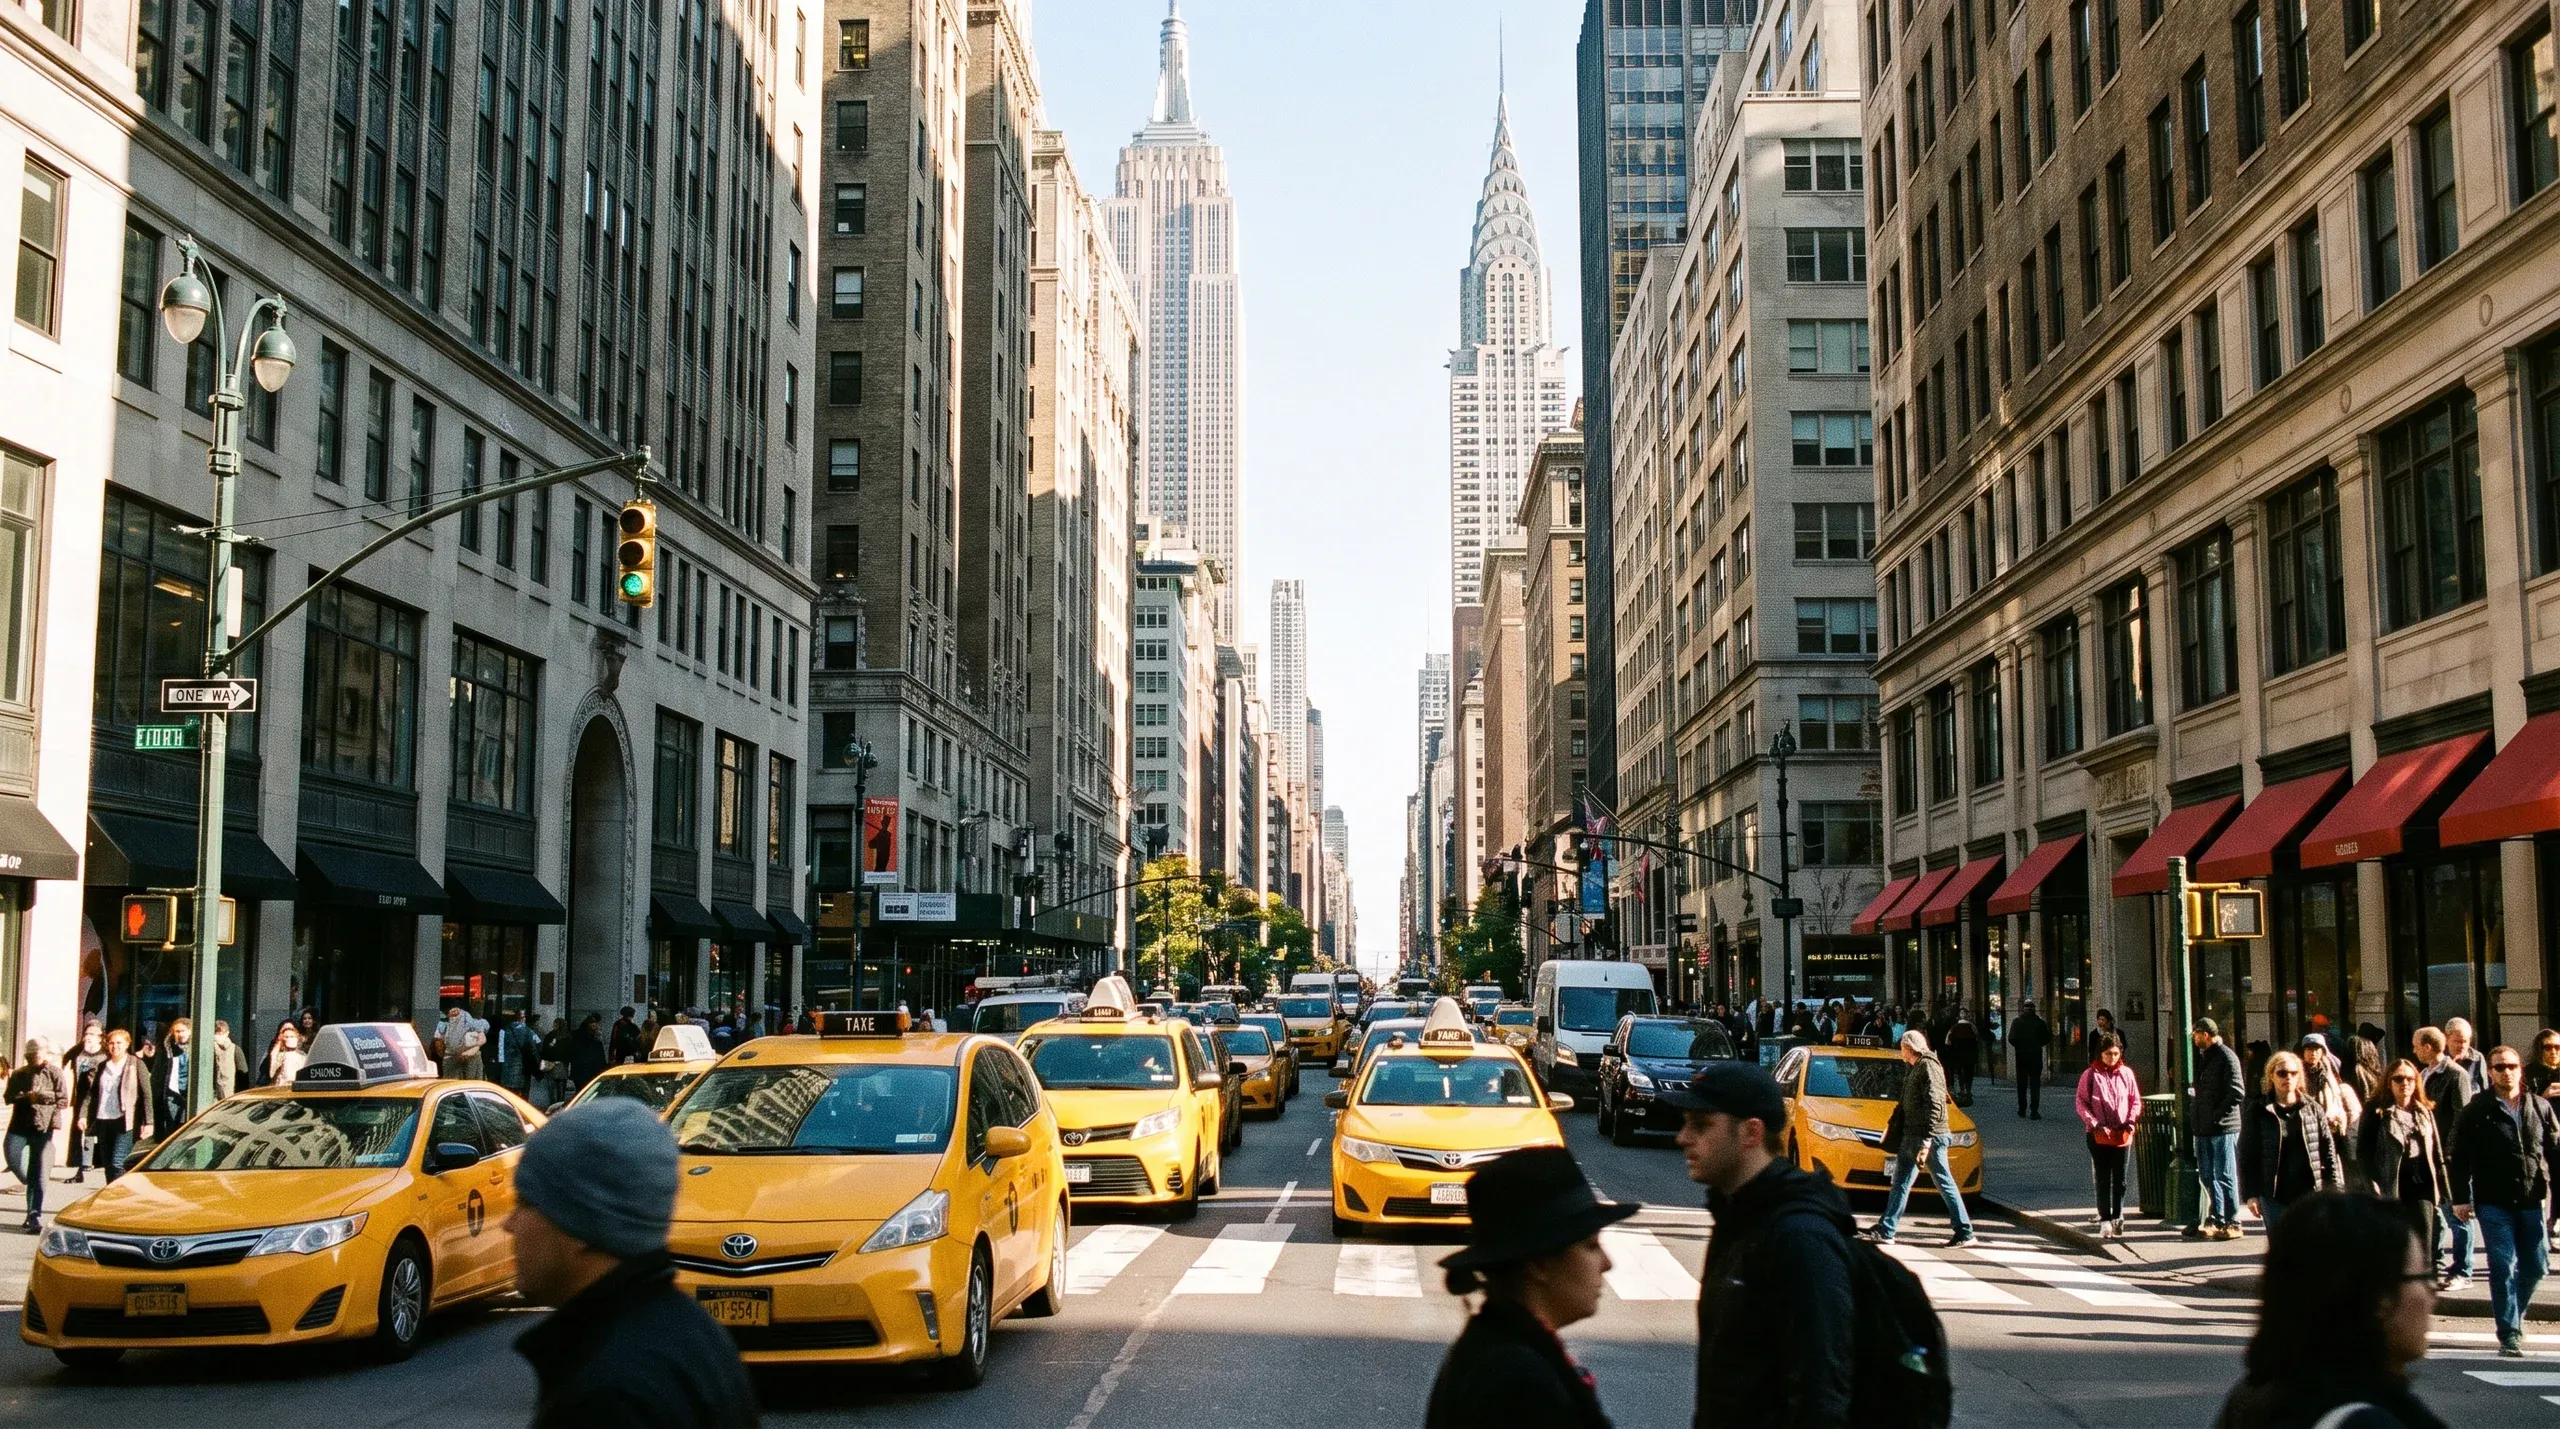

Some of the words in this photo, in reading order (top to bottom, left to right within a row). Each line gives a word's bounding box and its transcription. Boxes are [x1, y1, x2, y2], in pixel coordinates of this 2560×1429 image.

[176, 689, 204, 702] ONE
[212, 689, 240, 702] WAY
[845, 1017, 875, 1031] TAXE
